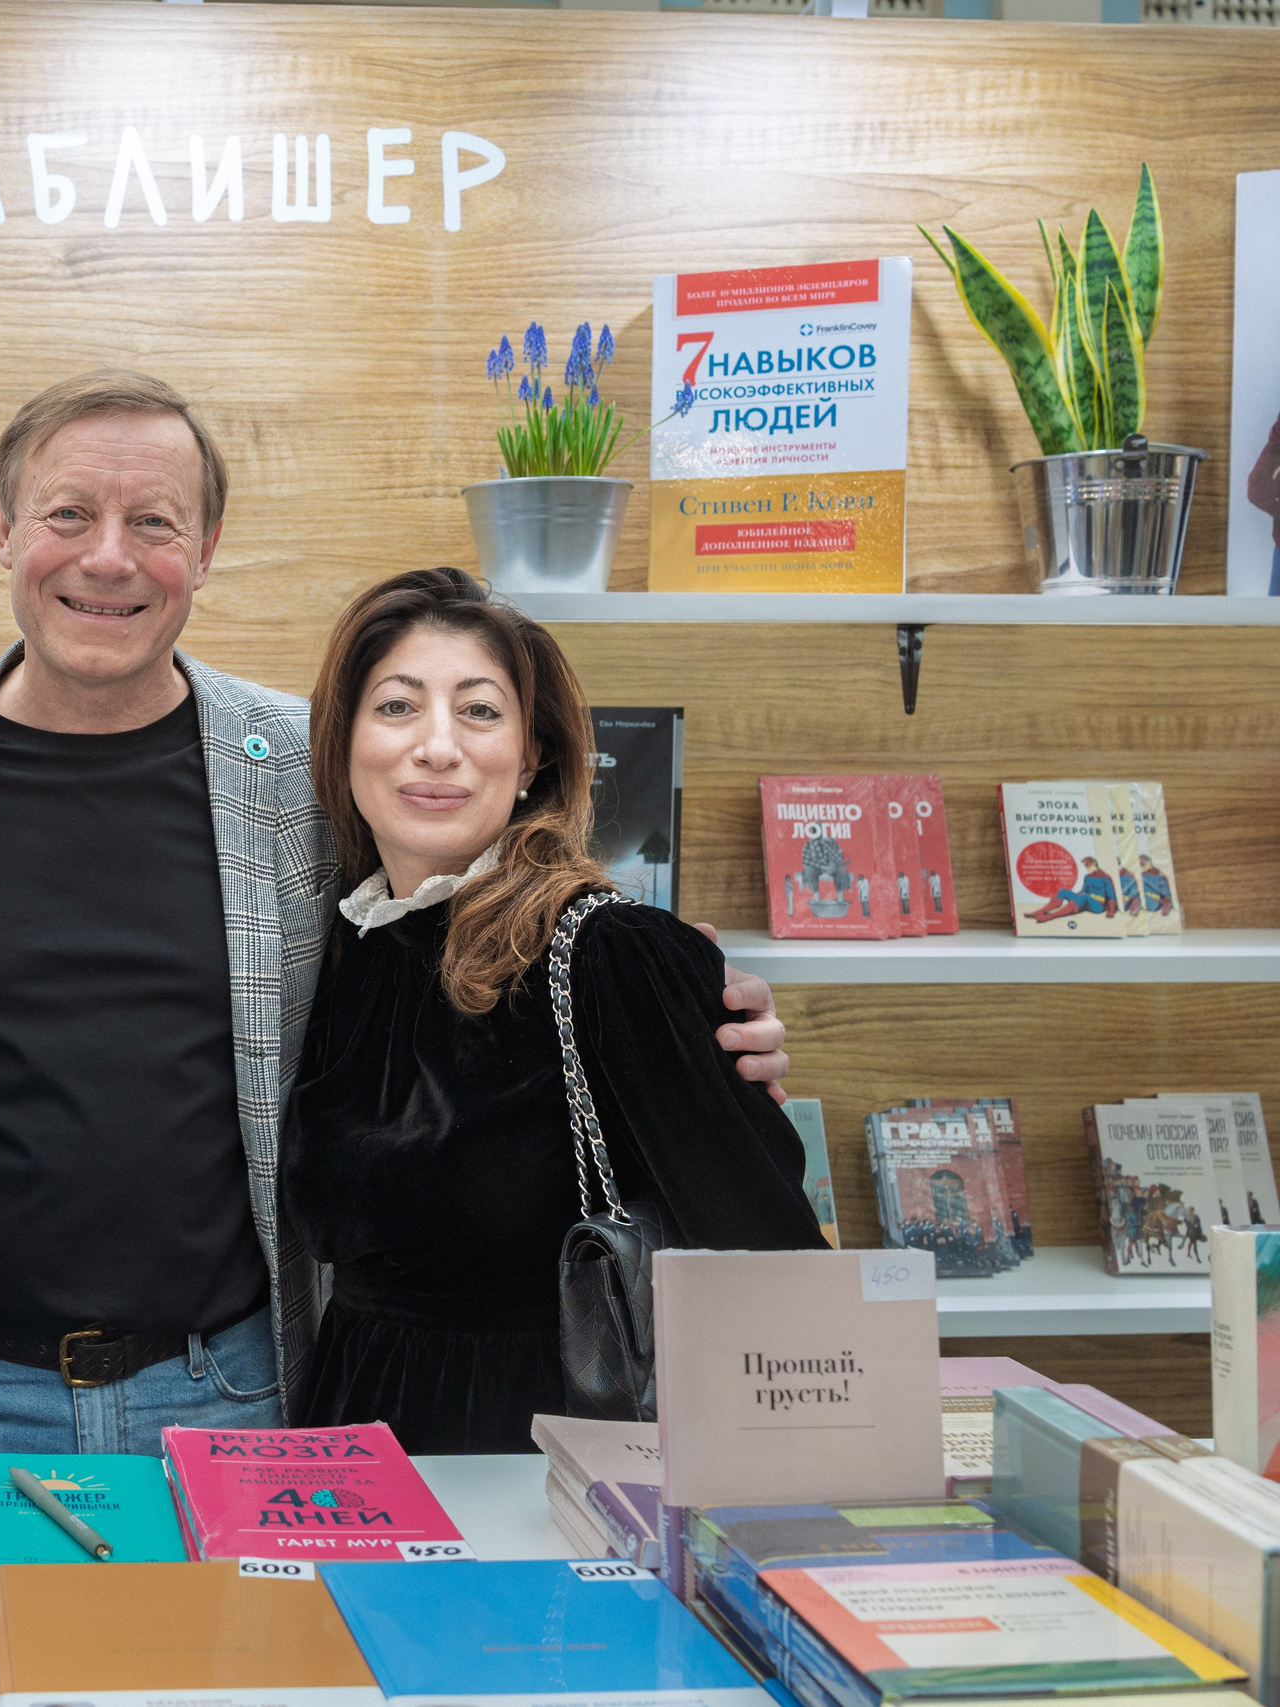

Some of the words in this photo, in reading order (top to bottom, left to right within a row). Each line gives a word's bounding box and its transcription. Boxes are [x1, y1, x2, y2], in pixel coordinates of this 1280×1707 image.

[731, 285, 794, 297] МИЛЛИОНОВ
[796, 278, 869, 292] ЭКЗЕМПЛЯРОВ
[717, 296, 764, 307] ПРОДАНО
[765, 295, 779, 303] ВО
[781, 293, 811, 303] ВСЕМ
[814, 291, 837, 301] МИРЕ
[816, 322, 878, 333] FranklinCovey
[676, 331, 715, 387] 7
[709, 344, 877, 377] НАВЫКОВ
[709, 397, 837, 435] ЛЮДЕЙ
[761, 442, 837, 453] ИНСТРУМЕНТЫ
[771, 453, 829, 464] ЛИЧНОСТИ
[679, 495, 772, 516] Стивен
[782, 492, 798, 511] Р.
[808, 490, 875, 512] Кови
[737, 524, 813, 539] ЮБИЛЕЙНОЕ
[701, 538, 791, 552] ДОПОЛНЕННОЕ
[1037, 801, 1079, 809] ЭПОХА
[777, 803, 862, 822] ПАЦИЕНТО
[1015, 813, 1102, 823] ВЫГОРАЮЩИХ
[792, 822, 851, 839] ЛОГИЯ
[1019, 826, 1102, 836] СУПЕРГЕРОЕВ
[881, 1121, 971, 1140] ГРАД
[1108, 1123, 1152, 1141] ПОЧЕМУ
[1156, 1123, 1199, 1141] РОССИЯ
[1147, 1144, 1201, 1160] ОТСТАЛА?
[872, 1267, 910, 1286] 450
[742, 1350, 864, 1381] Прощай,
[755, 1379, 851, 1411] грусть!
[205, 1433, 360, 1444] ТРЕНАЖЕР
[210, 1444, 375, 1458] МОЗГА
[4, 1491, 106, 1503] ТРАЖЕР
[63, 1502, 120, 1510] РИВЫЧЕК
[259, 1507, 393, 1527] ДНЕЙ
[277, 1538, 337, 1548] ГАРЕТ
[347, 1538, 393, 1548] МУР
[408, 1545, 462, 1556] 450
[241, 1562, 301, 1576] 600
[576, 1566, 637, 1577] 600
